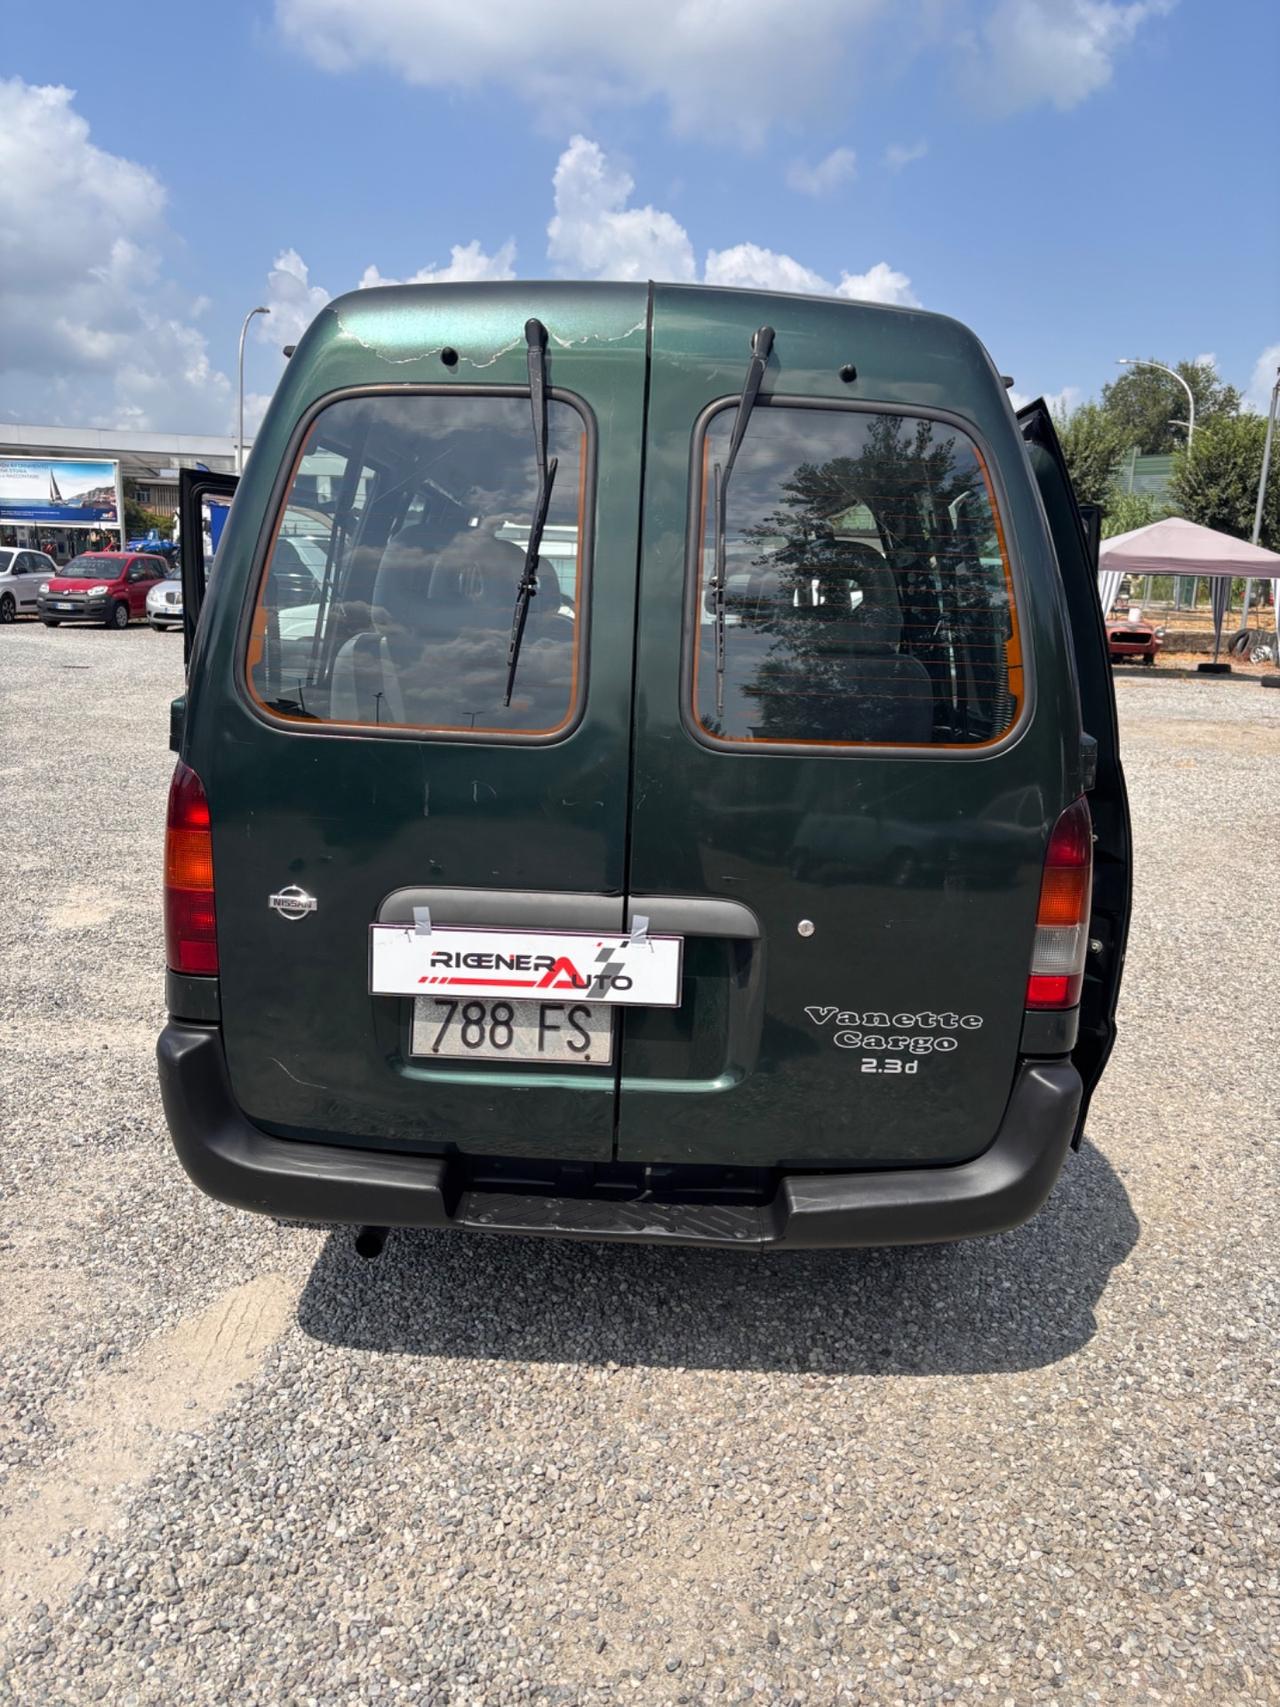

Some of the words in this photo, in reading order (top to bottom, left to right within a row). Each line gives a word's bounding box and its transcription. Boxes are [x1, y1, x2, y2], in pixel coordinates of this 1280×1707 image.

[273, 897, 312, 909] NISSAN
[432, 1000, 514, 1053] 788
[537, 1004, 592, 1053] FS
[804, 1006, 983, 1030] Vanette
[833, 1030, 958, 1055] Cargo
[860, 1058, 918, 1074] 2.3d
